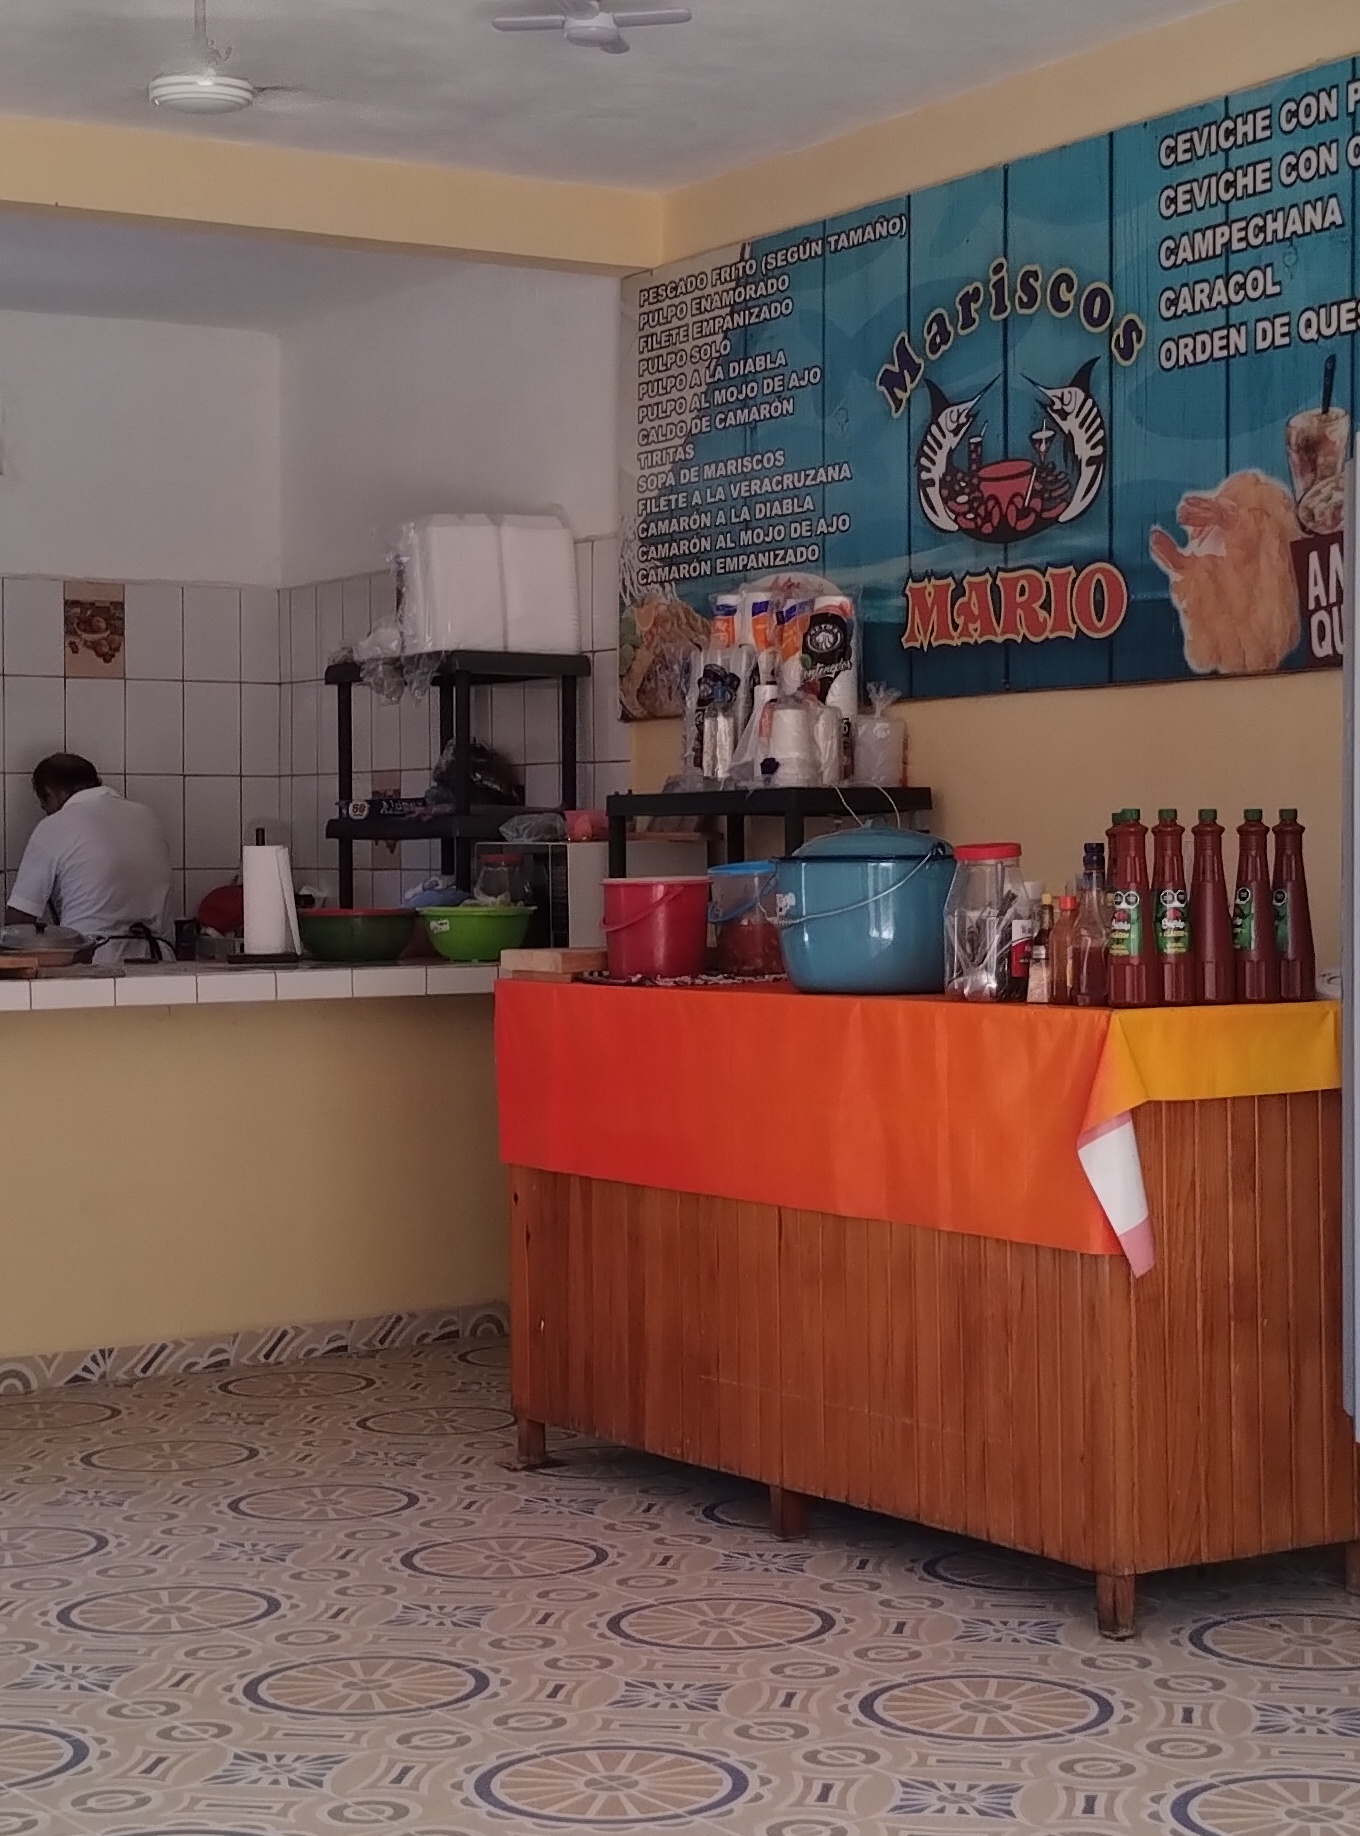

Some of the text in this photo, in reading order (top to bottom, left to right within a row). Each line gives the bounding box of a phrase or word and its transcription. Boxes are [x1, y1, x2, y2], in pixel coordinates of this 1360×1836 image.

[1159, 107, 1272, 169] CEVICHE
[1278, 85, 1339, 133] CON
[1159, 159, 1272, 219] CEVICHE
[1278, 140, 1339, 185] CON
[1159, 195, 1343, 270] CAMPECHANA
[640, 215, 907, 307] PESCADO FRITO (SEGÚN TAMAÑO)
[639, 274, 789, 330] PULPO ENAMORADO
[1159, 265, 1282, 320] CARACOL
[639, 299, 793, 353] FILETE EMPANIZADO
[876, 257, 1147, 418] Mariscos
[1159, 323, 1247, 371] ORDEN
[1255, 314, 1291, 351] DE
[638, 350, 787, 400] PULPO A LA DIABLA
[639, 339, 730, 377] PULPO SOLO
[638, 367, 822, 423] PULPO AL MOJO DE AJO
[638, 397, 794, 446] CALDO DE CAMARÓN
[638, 444, 695, 470] TIRITAS
[638, 450, 785, 493] SOPA DE MARISCOS
[638, 462, 852, 517] FILETE A LA VERACRUZANA
[638, 494, 815, 539] CAMARÓN A LA DIABLA
[638, 514, 851, 562] CAMARÓN AL MOJO DE AJO
[638, 544, 819, 585] CAMARÓN EMPANIZADO
[901, 560, 1129, 652] MARIO
